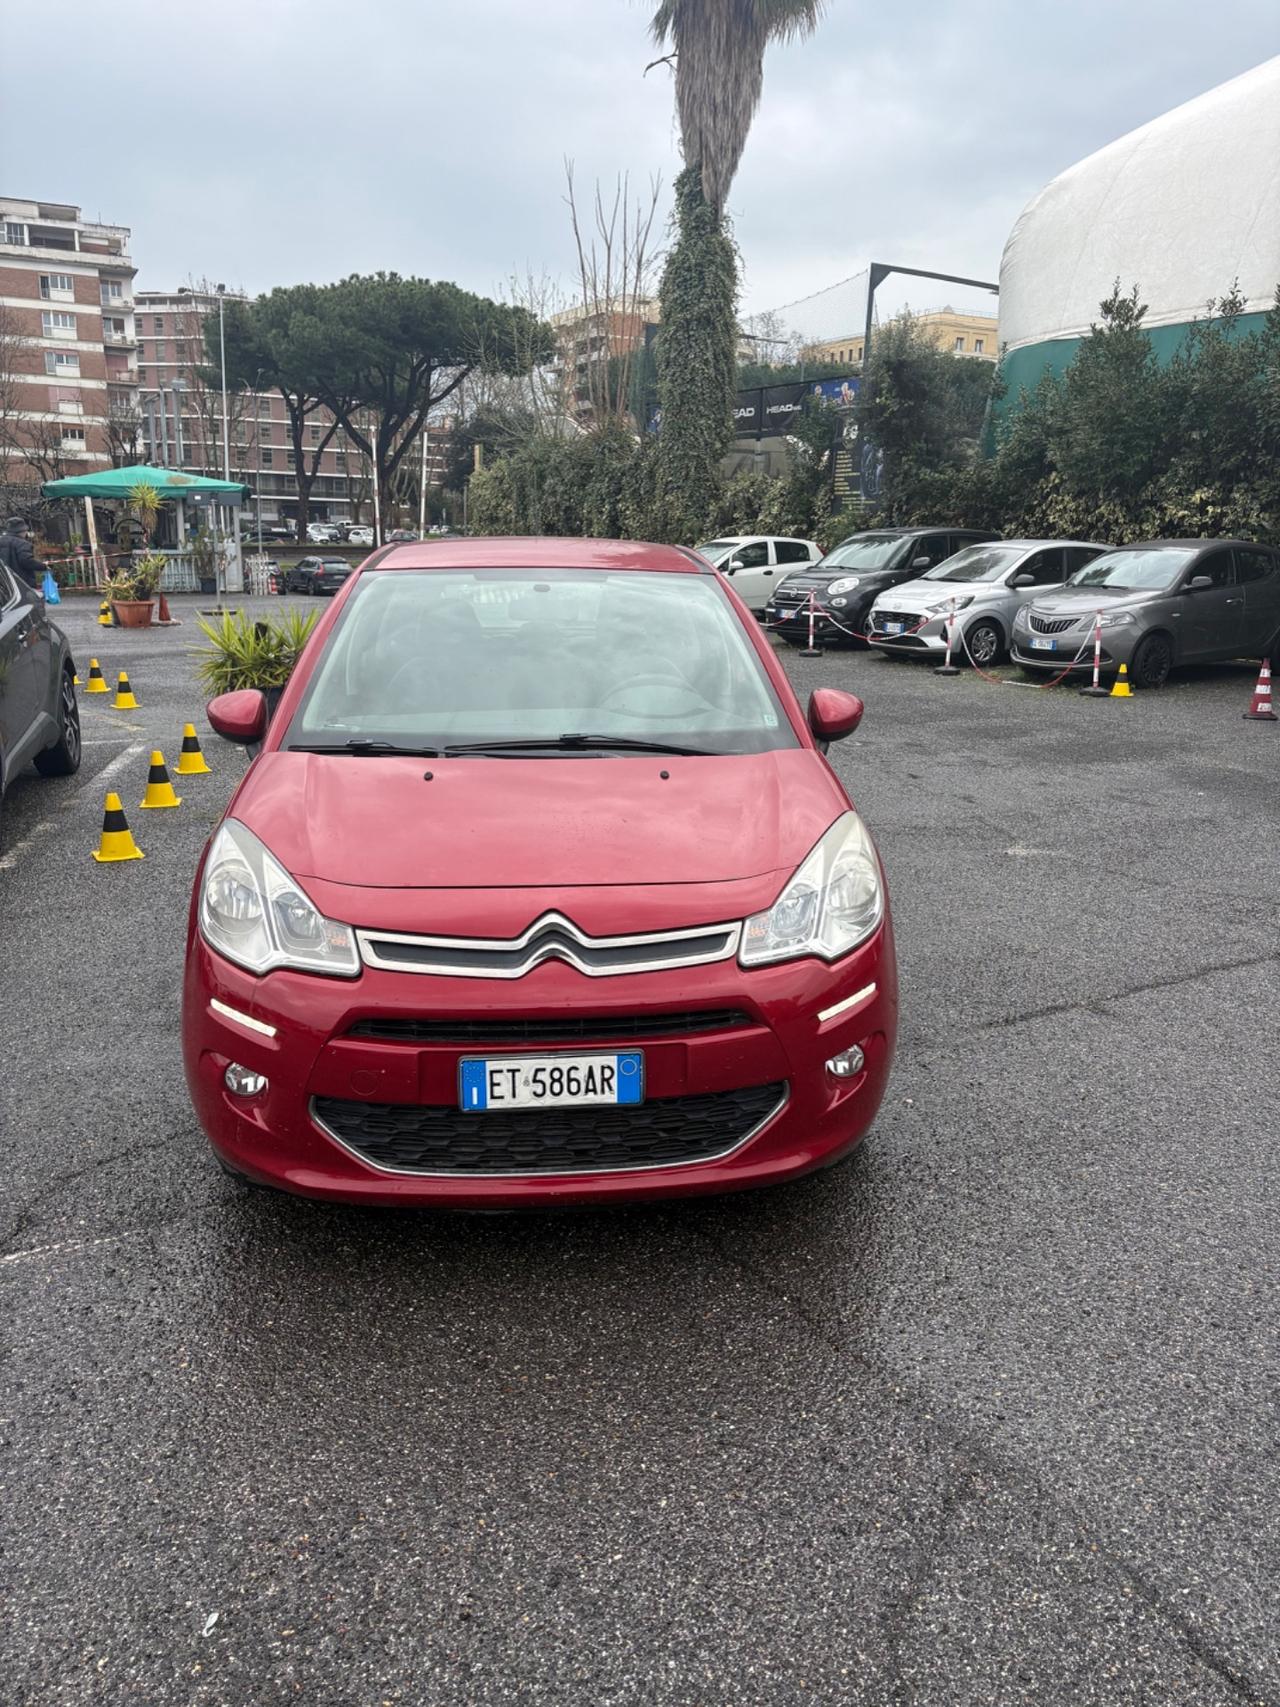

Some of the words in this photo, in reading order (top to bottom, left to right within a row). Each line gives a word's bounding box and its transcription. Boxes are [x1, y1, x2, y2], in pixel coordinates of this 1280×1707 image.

[733, 408, 755, 419] EAD
[489, 1069, 521, 1100] ET
[531, 1064, 615, 1098] 586AR
